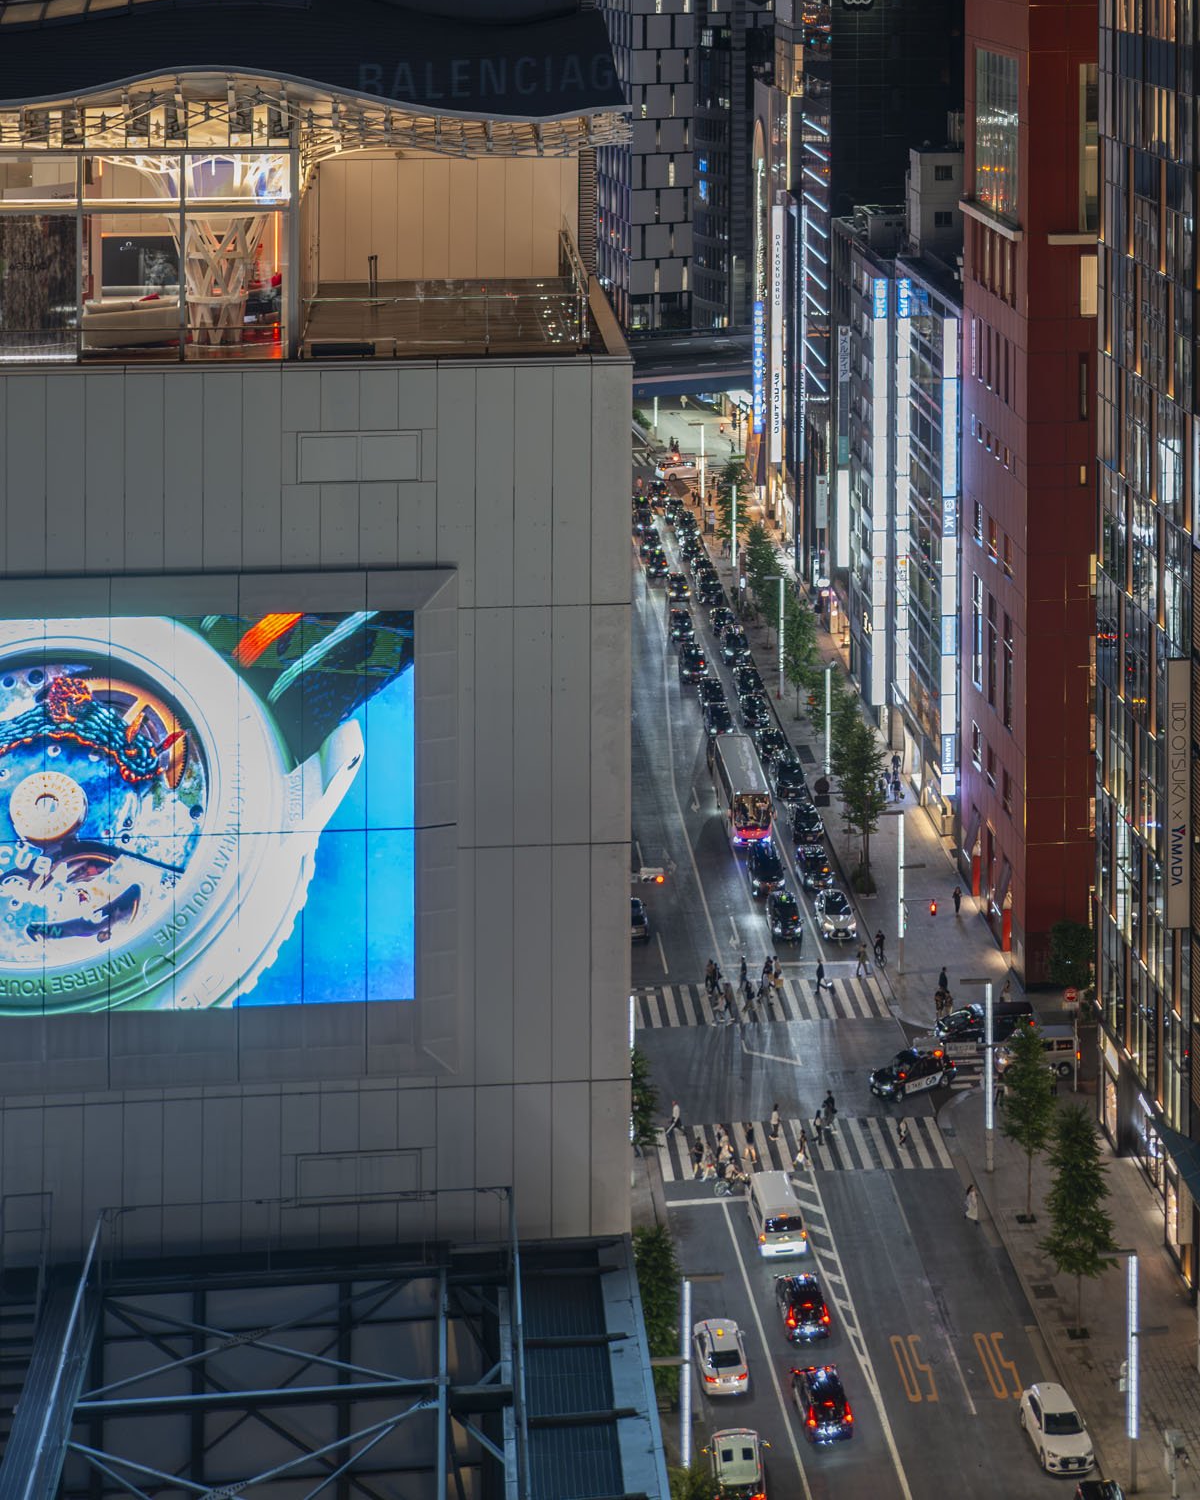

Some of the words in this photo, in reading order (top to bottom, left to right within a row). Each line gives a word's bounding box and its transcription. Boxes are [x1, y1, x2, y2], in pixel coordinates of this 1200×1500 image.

[754, 347, 763, 379] TOY
[754, 384, 763, 426] PARK
[1171, 735, 1187, 806] OTSUKA
[287, 774, 301, 824] SWISS
[1171, 824, 1187, 887] YAMADA
[192, 873, 222, 909] YOU
[154, 904, 199, 947] LOVE
[51, 951, 137, 993] IMMERSE
[889, 1334, 939, 1403] 50
[972, 1331, 1024, 1399] 50
